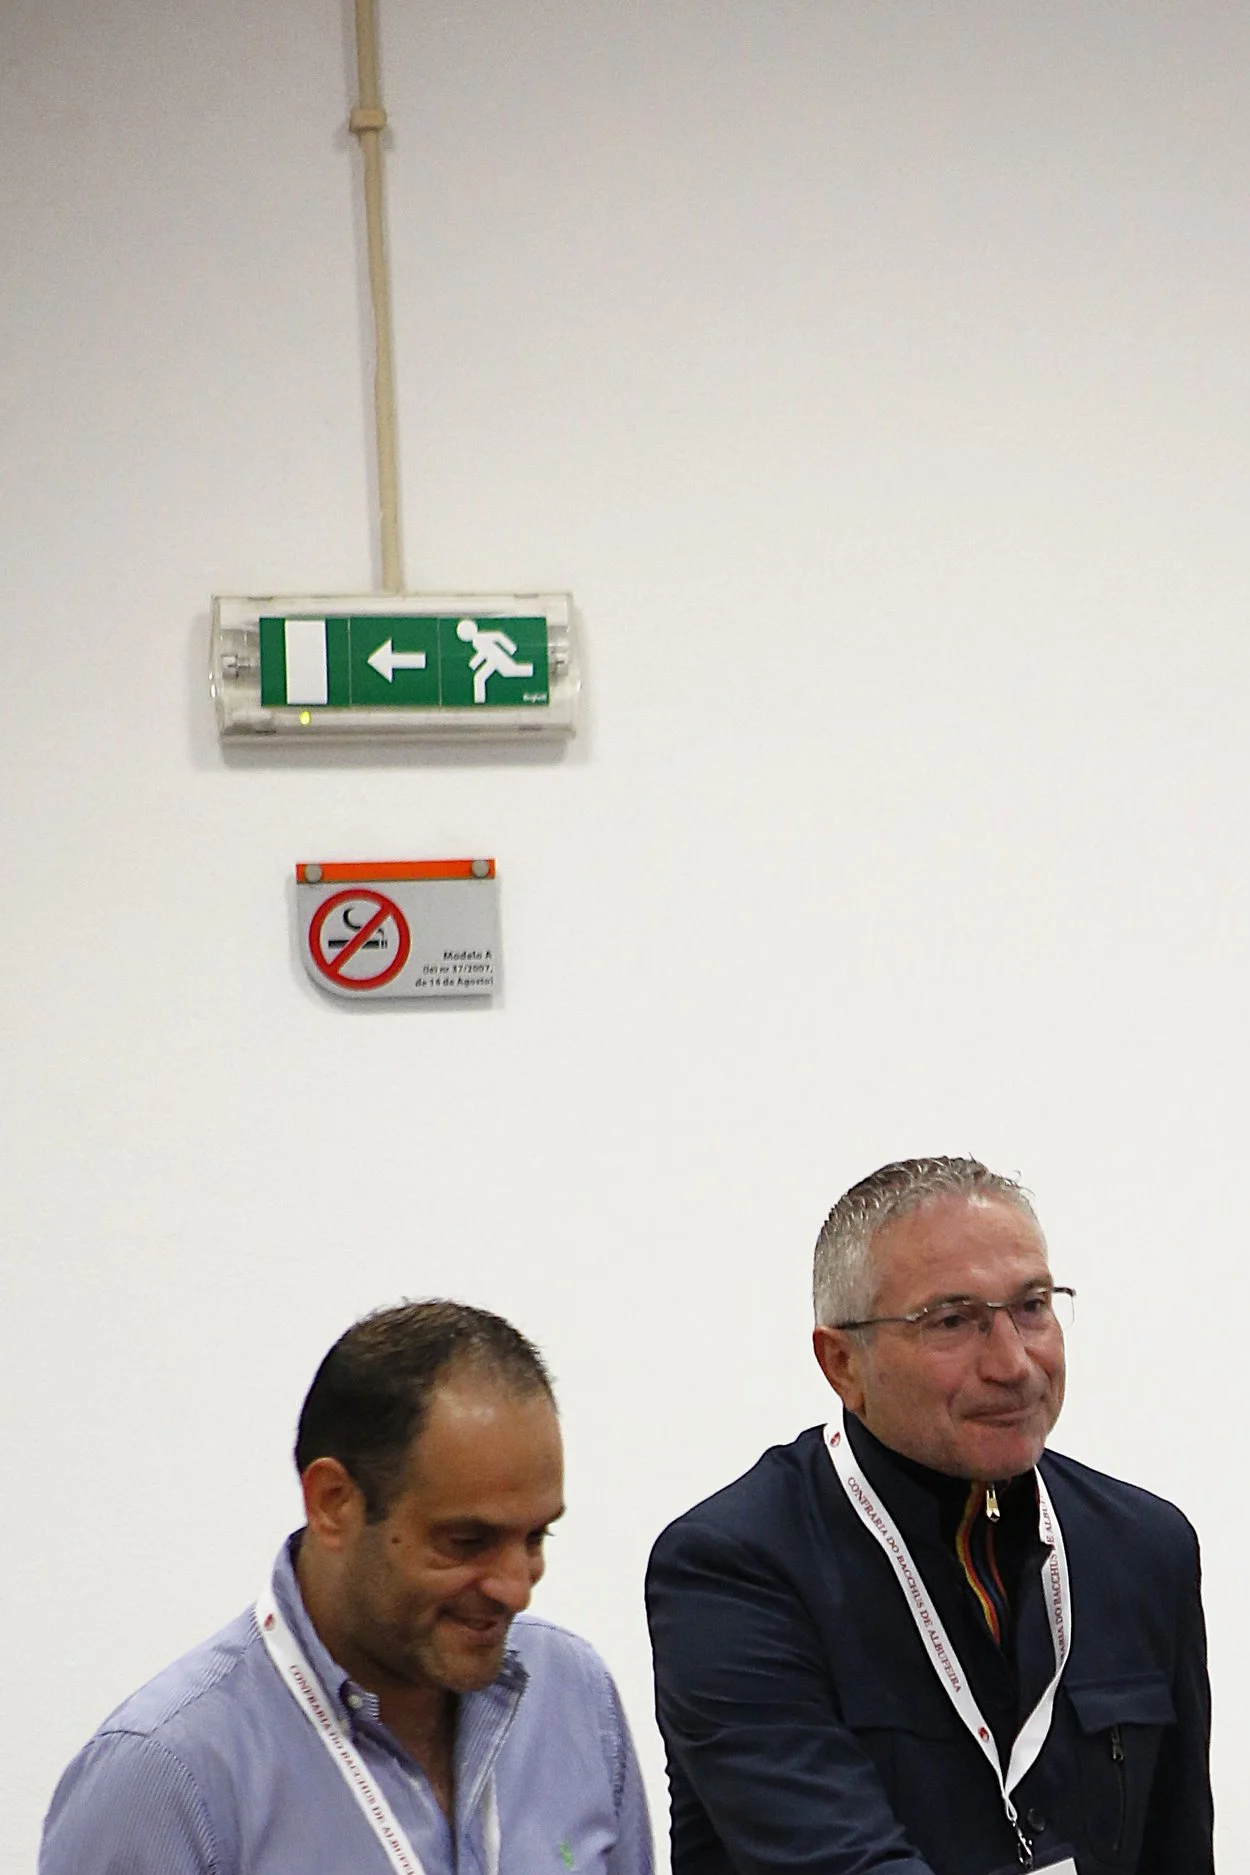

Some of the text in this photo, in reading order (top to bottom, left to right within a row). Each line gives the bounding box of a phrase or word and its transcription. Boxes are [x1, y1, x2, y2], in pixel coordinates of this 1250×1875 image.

[443, 951, 492, 960] Modelo A
[847, 1476, 962, 1694] CONFRARIA DO BACCHUS DE ALBUFEIRA
[289, 1664, 332, 1730] CONFRARIA
[341, 1750, 377, 1805] BACCHUS
